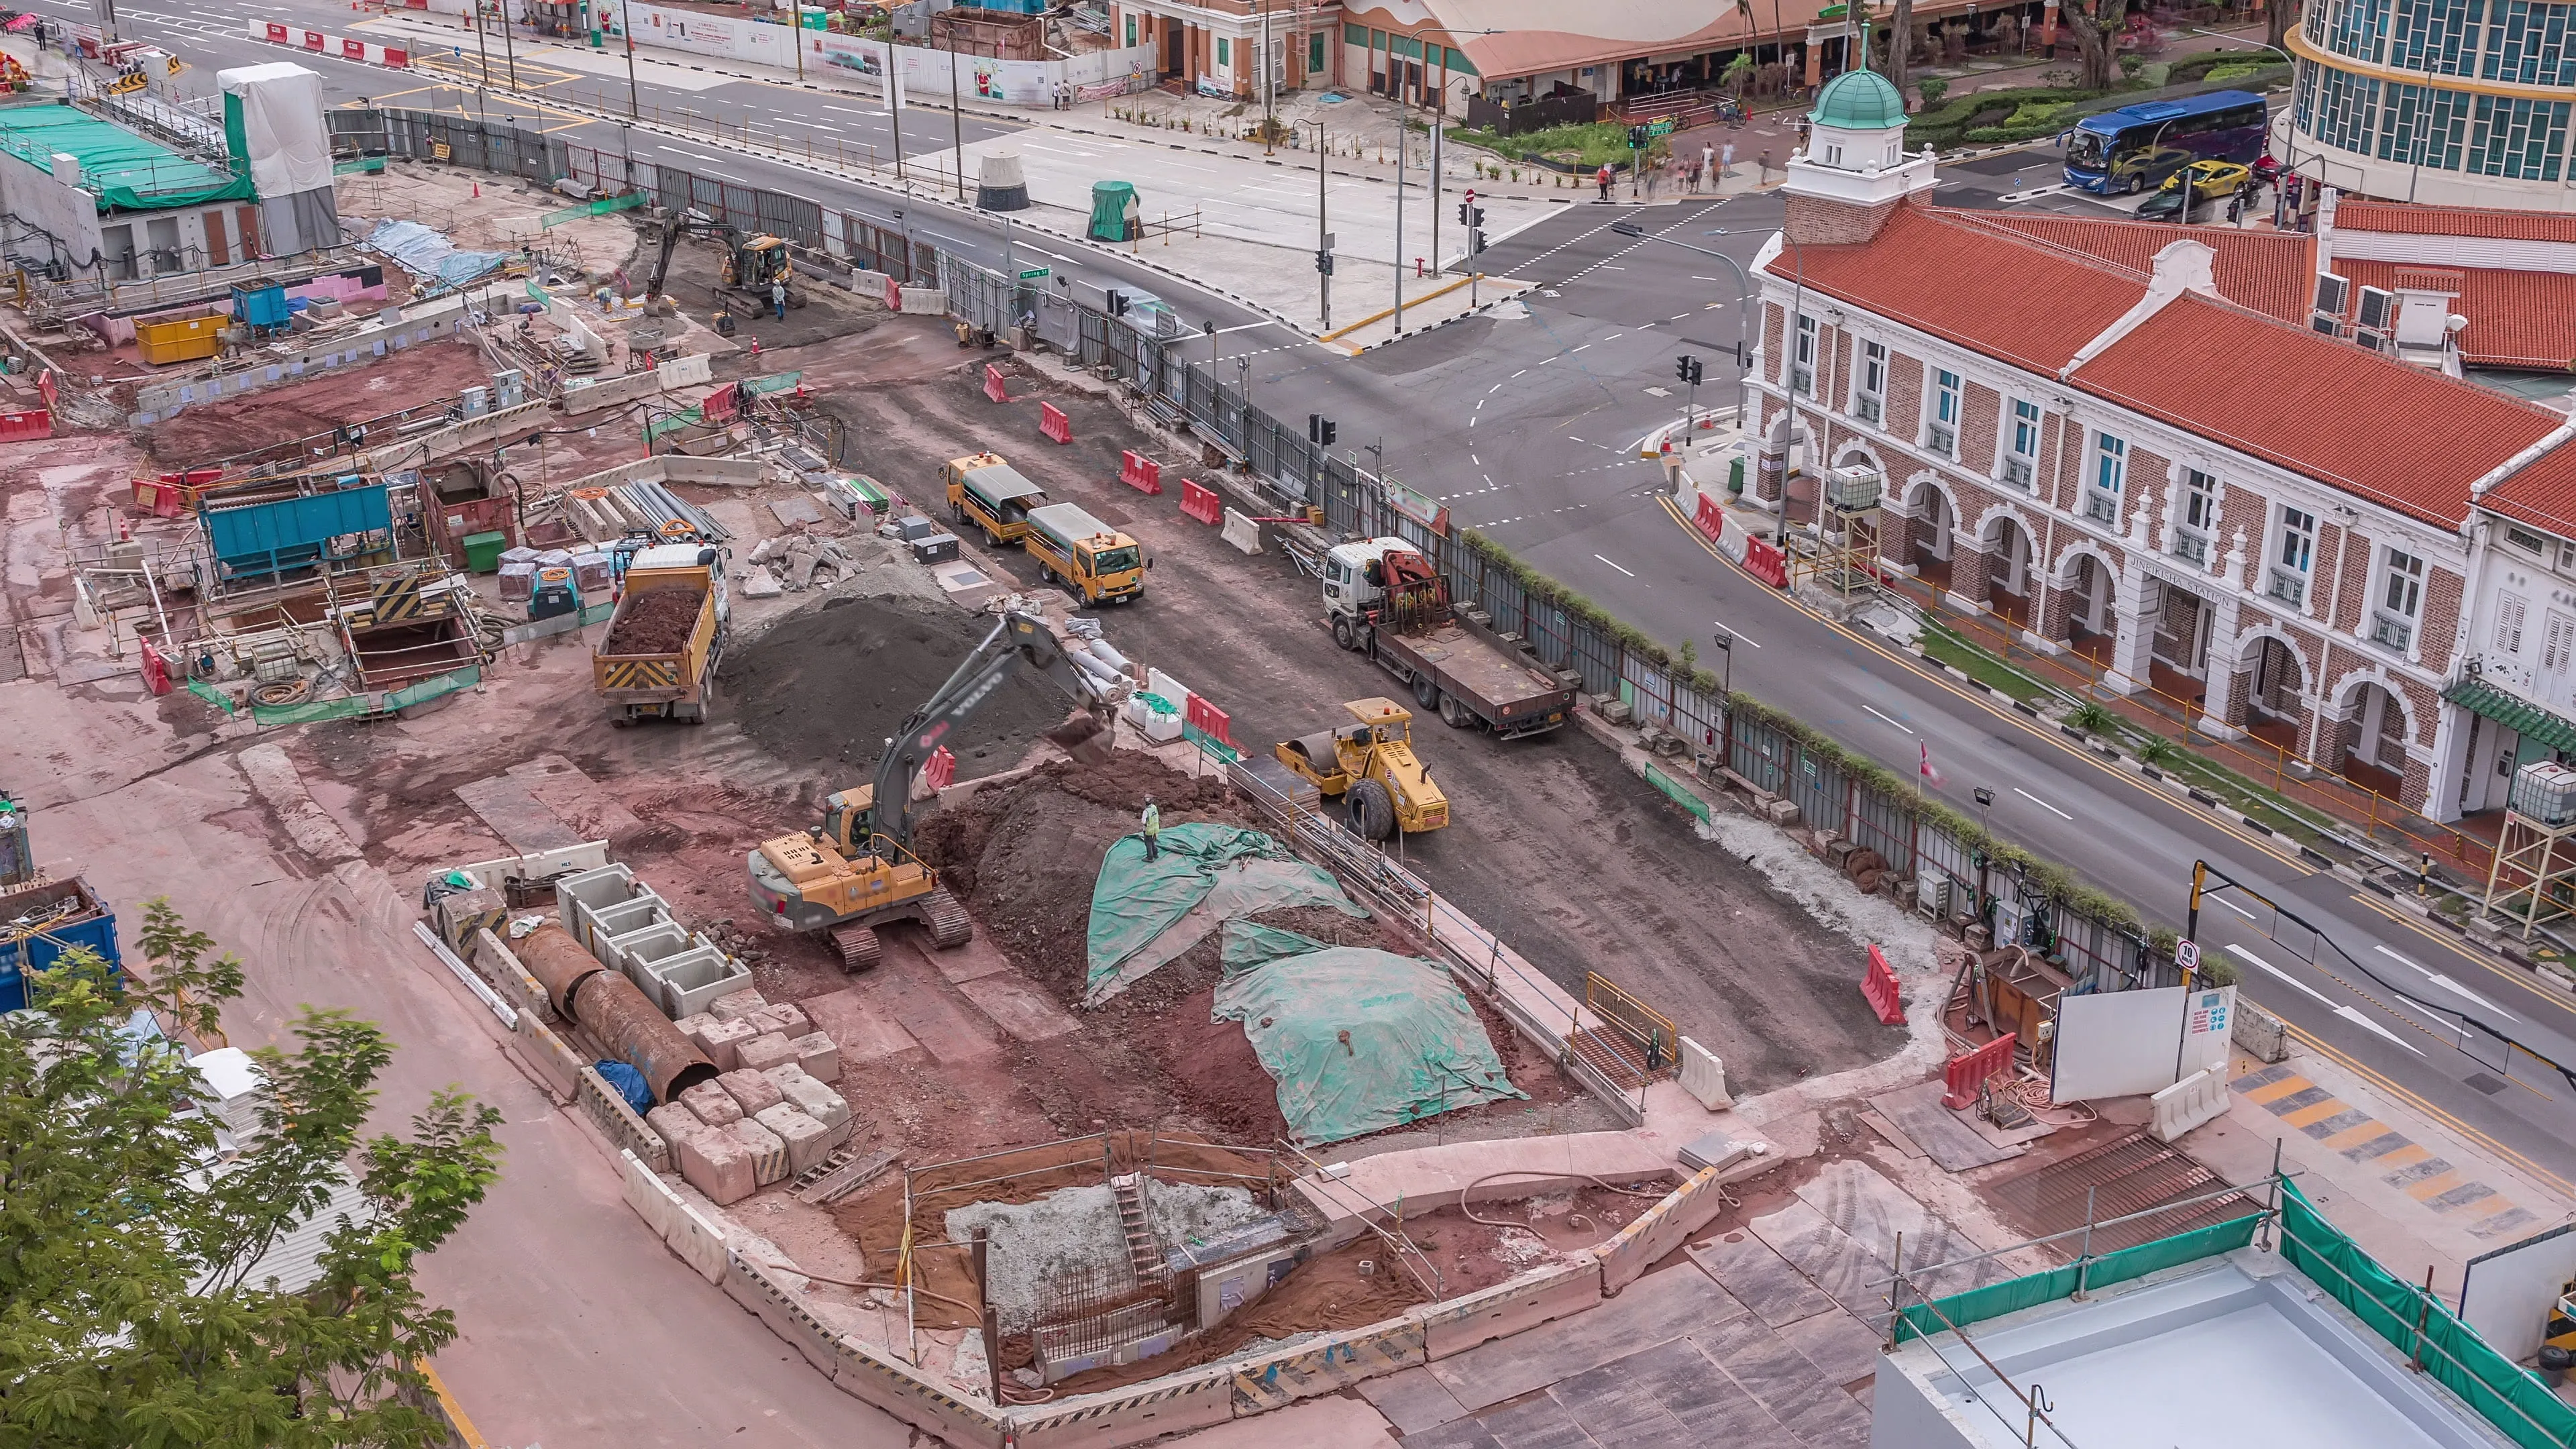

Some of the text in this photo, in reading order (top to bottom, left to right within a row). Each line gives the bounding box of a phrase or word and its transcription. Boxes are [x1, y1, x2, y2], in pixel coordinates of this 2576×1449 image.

[2131, 557, 2230, 606] JINRIKISHA STATION
[2184, 945, 2193, 958] 10
[2182, 955, 2193, 965] km/h
